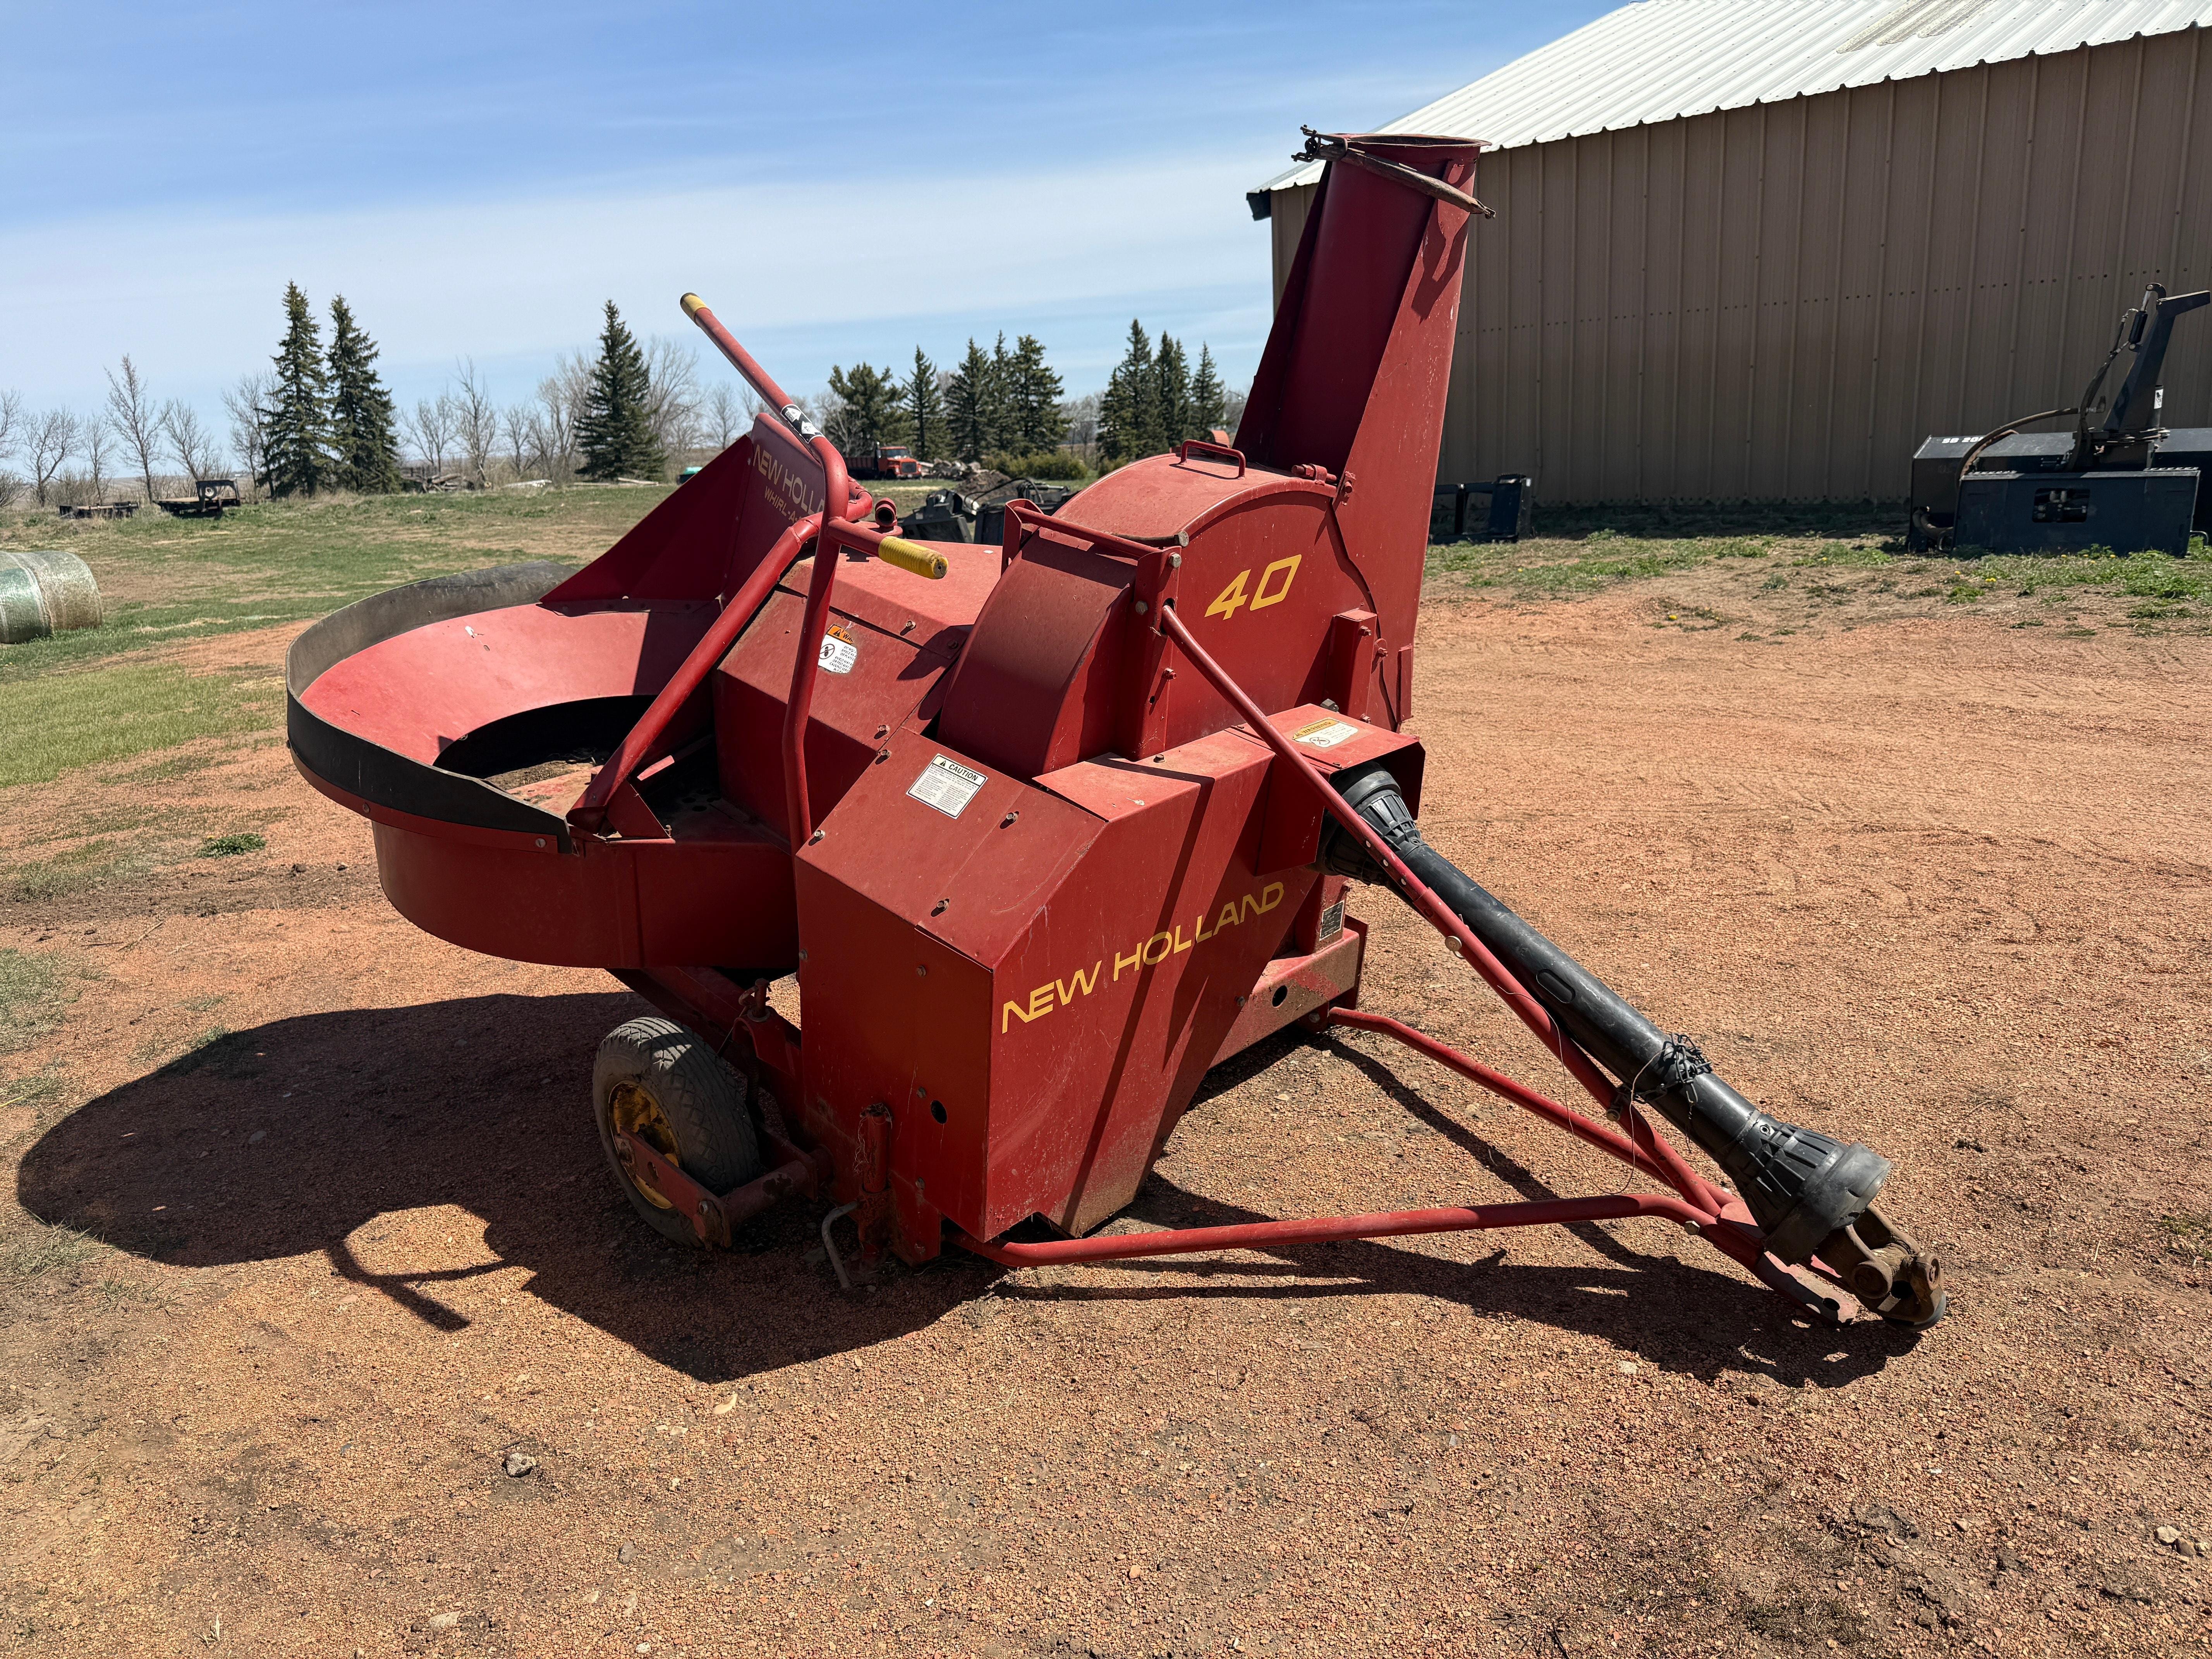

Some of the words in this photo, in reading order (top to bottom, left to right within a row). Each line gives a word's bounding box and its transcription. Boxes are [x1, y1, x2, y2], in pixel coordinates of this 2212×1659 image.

[753, 444, 783, 485] NEW
[1204, 554, 1302, 620] 40
[948, 764, 979, 781] CAUTION
[1002, 960, 1102, 1034] NEW
[1113, 881, 1285, 982] HOLLAND
